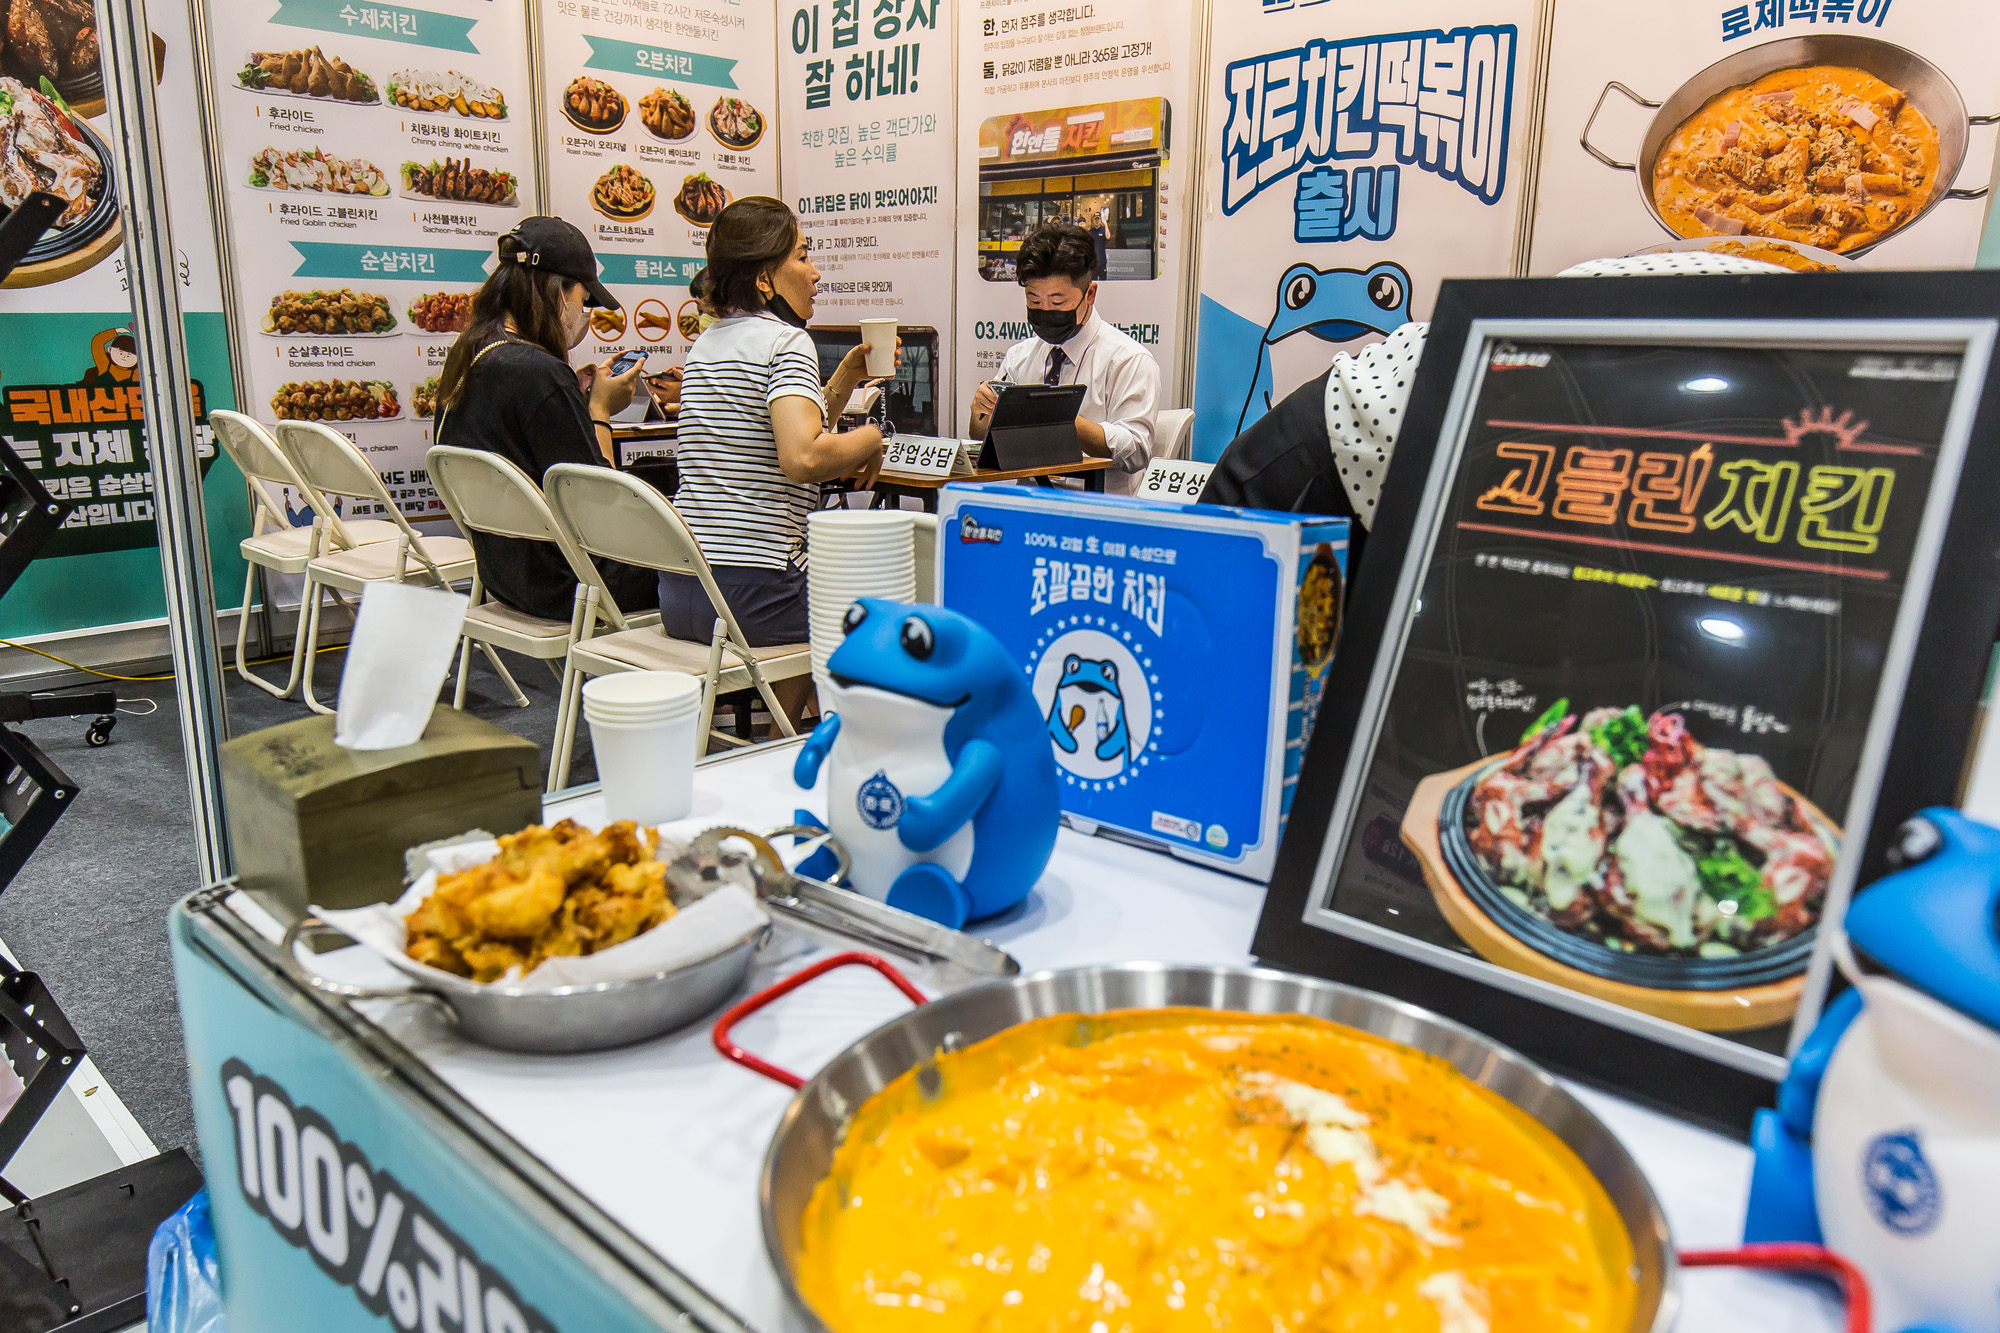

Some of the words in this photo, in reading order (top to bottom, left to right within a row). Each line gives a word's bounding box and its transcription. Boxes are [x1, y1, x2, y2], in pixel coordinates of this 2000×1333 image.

[339, 3, 418, 36] 수제치킨
[557, 2, 577, 16] 맛은
[580, 5, 601, 21] 물론
[604, 9, 642, 28] 건강까지
[645, 16, 672, 33] 생각한
[662, 4, 692, 19] 72시간
[695, 9, 745, 29] 저온숙성시켜
[792, 4, 818, 54] 이
[832, 0, 859, 49] 집
[983, 18, 999, 37] 한,
[1001, 17, 1018, 34] 먼저
[1020, 12, 1046, 30] 점주를
[1048, 4, 1096, 25] 생각합니다.
[635, 49, 693, 76] 오븐치킨
[983, 60, 998, 80] 둘,
[1001, 59, 1026, 76] 닭값이
[1028, 57, 1052, 73] 저렴할
[1054, 55, 1063, 69] 뿐
[1064, 50, 1090, 67] 아니라
[1092, 45, 1118, 64] 365일
[1121, 41, 1152, 60] 고정가!
[805, 58, 834, 110] 잘
[845, 42, 920, 101] 하네!
[268, 106, 315, 123] 후라이드
[1224, 27, 1515, 212] 진로치킨떡볶이
[269, 121, 290, 132] Fried
[292, 124, 324, 135] chicken
[411, 121, 450, 138] 치링치링
[454, 126, 501, 144] 화이트치킨
[801, 129, 824, 148] 착한
[827, 126, 853, 145] 맛집,
[857, 121, 881, 143] 높은
[886, 113, 937, 138] 객단가와
[1061, 119, 1104, 150] 치킨
[482, 143, 509, 154] chicken
[566, 137, 596, 149] 오븐구이
[598, 140, 627, 152] 오리지널
[639, 145, 666, 156] 오븐구이
[834, 147, 857, 168] 높은
[861, 143, 898, 165] 수익률
[738, 155, 751, 166] 치킨
[849, 190, 871, 210] 닭이
[875, 185, 938, 209] 맛있어야지!
[1297, 168, 1398, 240] 출시
[279, 202, 323, 218] 후라이드
[327, 205, 378, 221] 고블린치킨
[280, 217, 300, 226] Fried
[302, 218, 327, 228] Goblin
[329, 219, 357, 229] chicken
[422, 212, 477, 228] 사천블랙치킨
[692, 230, 708, 240] 사천
[817, 238, 824, 250] 닭
[826, 238, 832, 249] 그
[834, 237, 854, 249] 자체가
[855, 236, 879, 247] 맛있다.
[360, 250, 435, 273] 순살치킨
[634, 260, 677, 279] 플러스
[831, 282, 856, 293] 튀김으로
[857, 282, 871, 293] 더욱
[872, 281, 893, 292] 맛있게
[1111, 323, 1159, 344] 하다!
[288, 345, 354, 358] 순살후라이드
[289, 359, 324, 369] Boneless
[346, 358, 376, 369] chicken
[52, 429, 134, 467] 자체
[889, 442, 953, 468] 창업상담
[410, 470, 431, 484] 배
[1148, 468, 1206, 496] 창업상
[352, 505, 371, 515] 세트
[1024, 532, 1058, 549] 100%
[1030, 557, 1115, 616] 초깔끔한
[1122, 569, 1166, 639] 치킨
